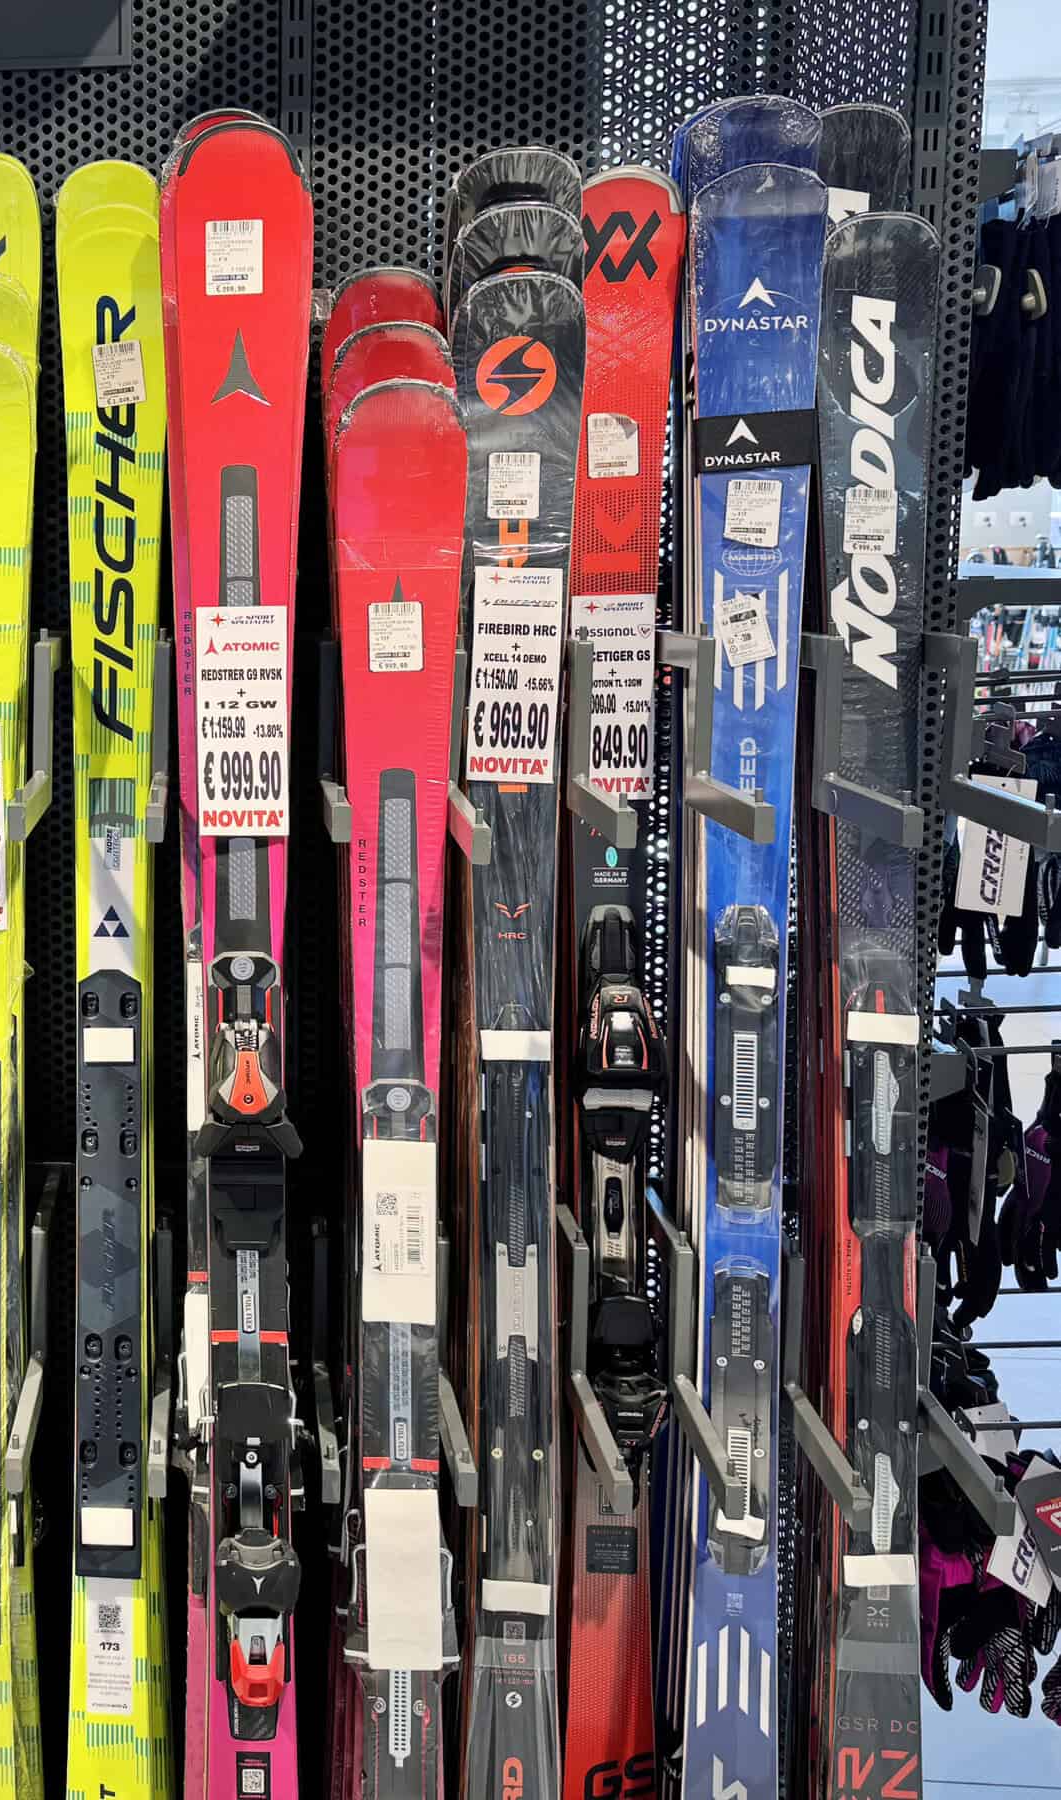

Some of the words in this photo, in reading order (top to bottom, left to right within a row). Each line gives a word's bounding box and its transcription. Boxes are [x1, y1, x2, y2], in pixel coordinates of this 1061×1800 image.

[704, 315, 808, 332] DYNASTAR
[705, 451, 781, 466] DYNASTAR
[831, 295, 897, 690] NODICA
[478, 623, 532, 635] FIREBIRD
[533, 624, 557, 636] HRC
[575, 627, 636, 639] RSSIGNOL
[222, 641, 280, 652] ATOMIC
[484, 653, 509, 663] XCELL
[511, 654, 521, 663] 14
[523, 654, 547, 664] DEMO
[636, 650, 650, 661] GS
[201, 669, 245, 681] REDSTRER
[247, 669, 258, 681] G9
[259, 668, 283, 681] RVSK
[592, 679, 613, 688] OTION
[217, 701, 240, 709] 12
[246, 700, 278, 709] GW
[489, 702, 550, 750] 969.90
[592, 724, 648, 769] 849.90
[469, 757, 548, 776] NOVITA'
[220, 750, 282, 801] 999.90
[203, 810, 284, 828] NOVITA'
[358, 839, 367, 927] REDSTER
[498, 932, 528, 940] HRC
[100, 1642, 120, 1652] 173
[837, 1716, 879, 1731] GSR
[890, 1719, 918, 1734] DC
